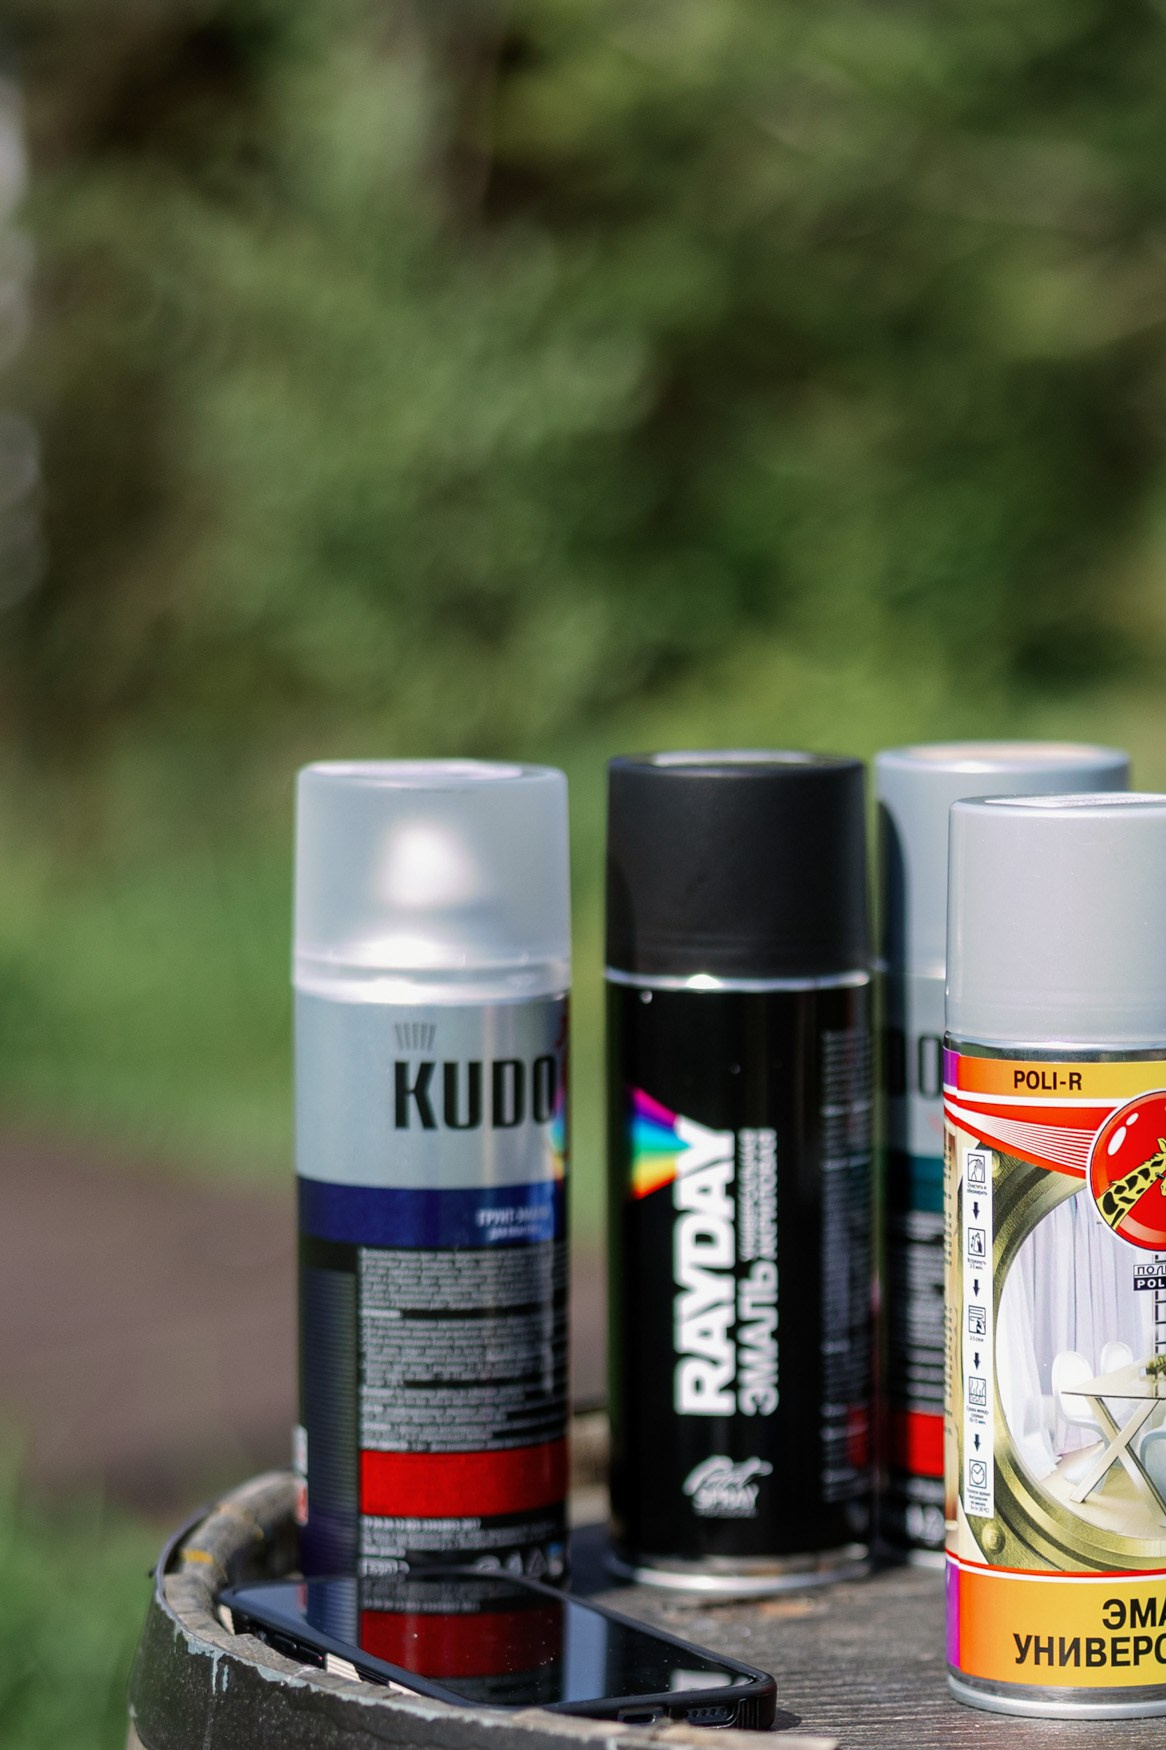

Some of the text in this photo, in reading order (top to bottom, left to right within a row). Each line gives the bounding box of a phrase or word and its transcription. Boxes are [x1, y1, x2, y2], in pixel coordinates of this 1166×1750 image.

[394, 1054, 556, 1130] KUDO
[1013, 1070, 1082, 1090] POLI-R
[674, 1114, 735, 1416] RAYDAY
[738, 1262, 779, 1416] ЭМАЛЬ
